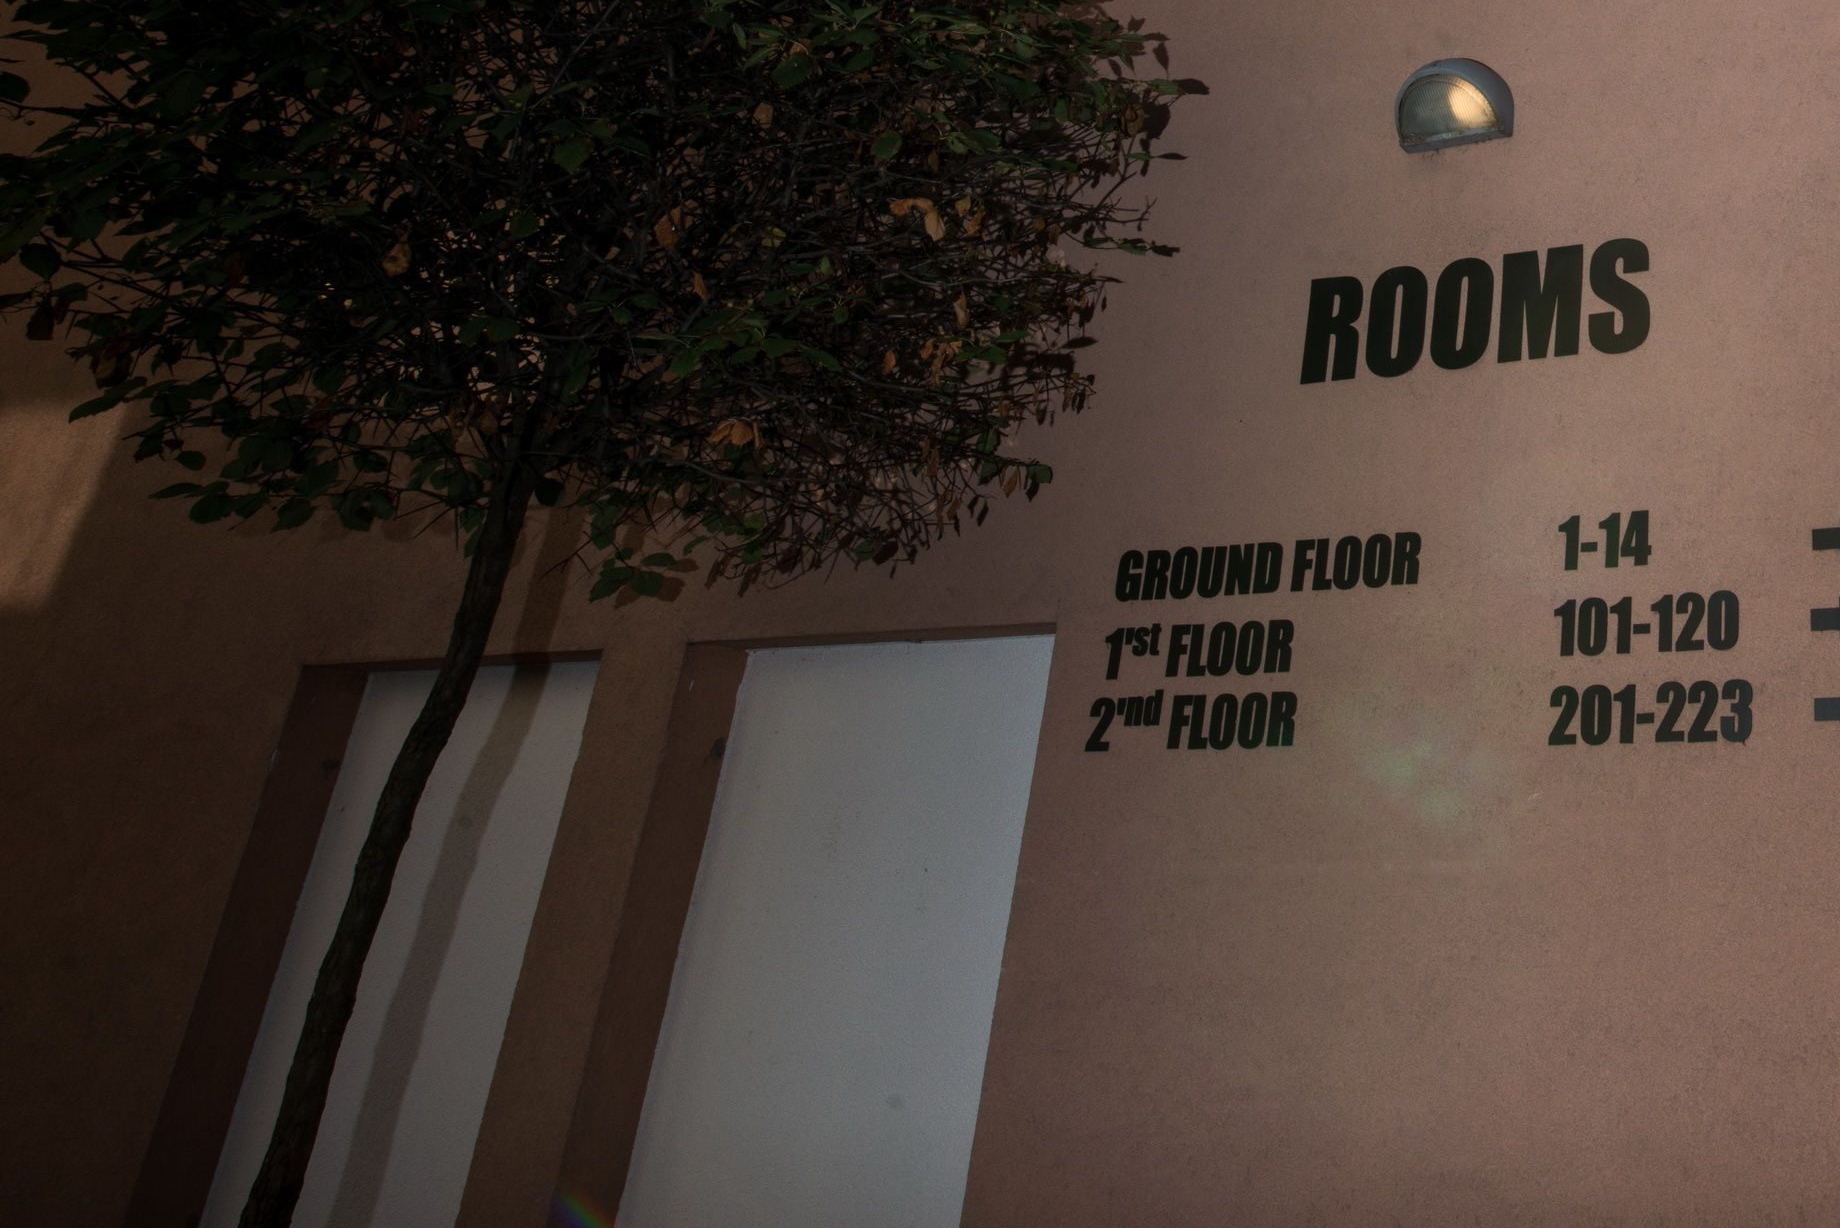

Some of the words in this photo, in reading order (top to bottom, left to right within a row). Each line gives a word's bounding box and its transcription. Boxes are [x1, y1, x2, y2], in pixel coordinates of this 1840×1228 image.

[1300, 238, 1651, 385] ROOMS
[1115, 541, 1284, 606] GROUND
[1290, 531, 1422, 593] FLOOR
[1558, 509, 1652, 571] 1-14
[1164, 619, 1295, 678] FLOOR
[1553, 590, 1740, 657] 101-120
[1166, 690, 1298, 751] FLOOR
[1548, 678, 1754, 746] 201-223
